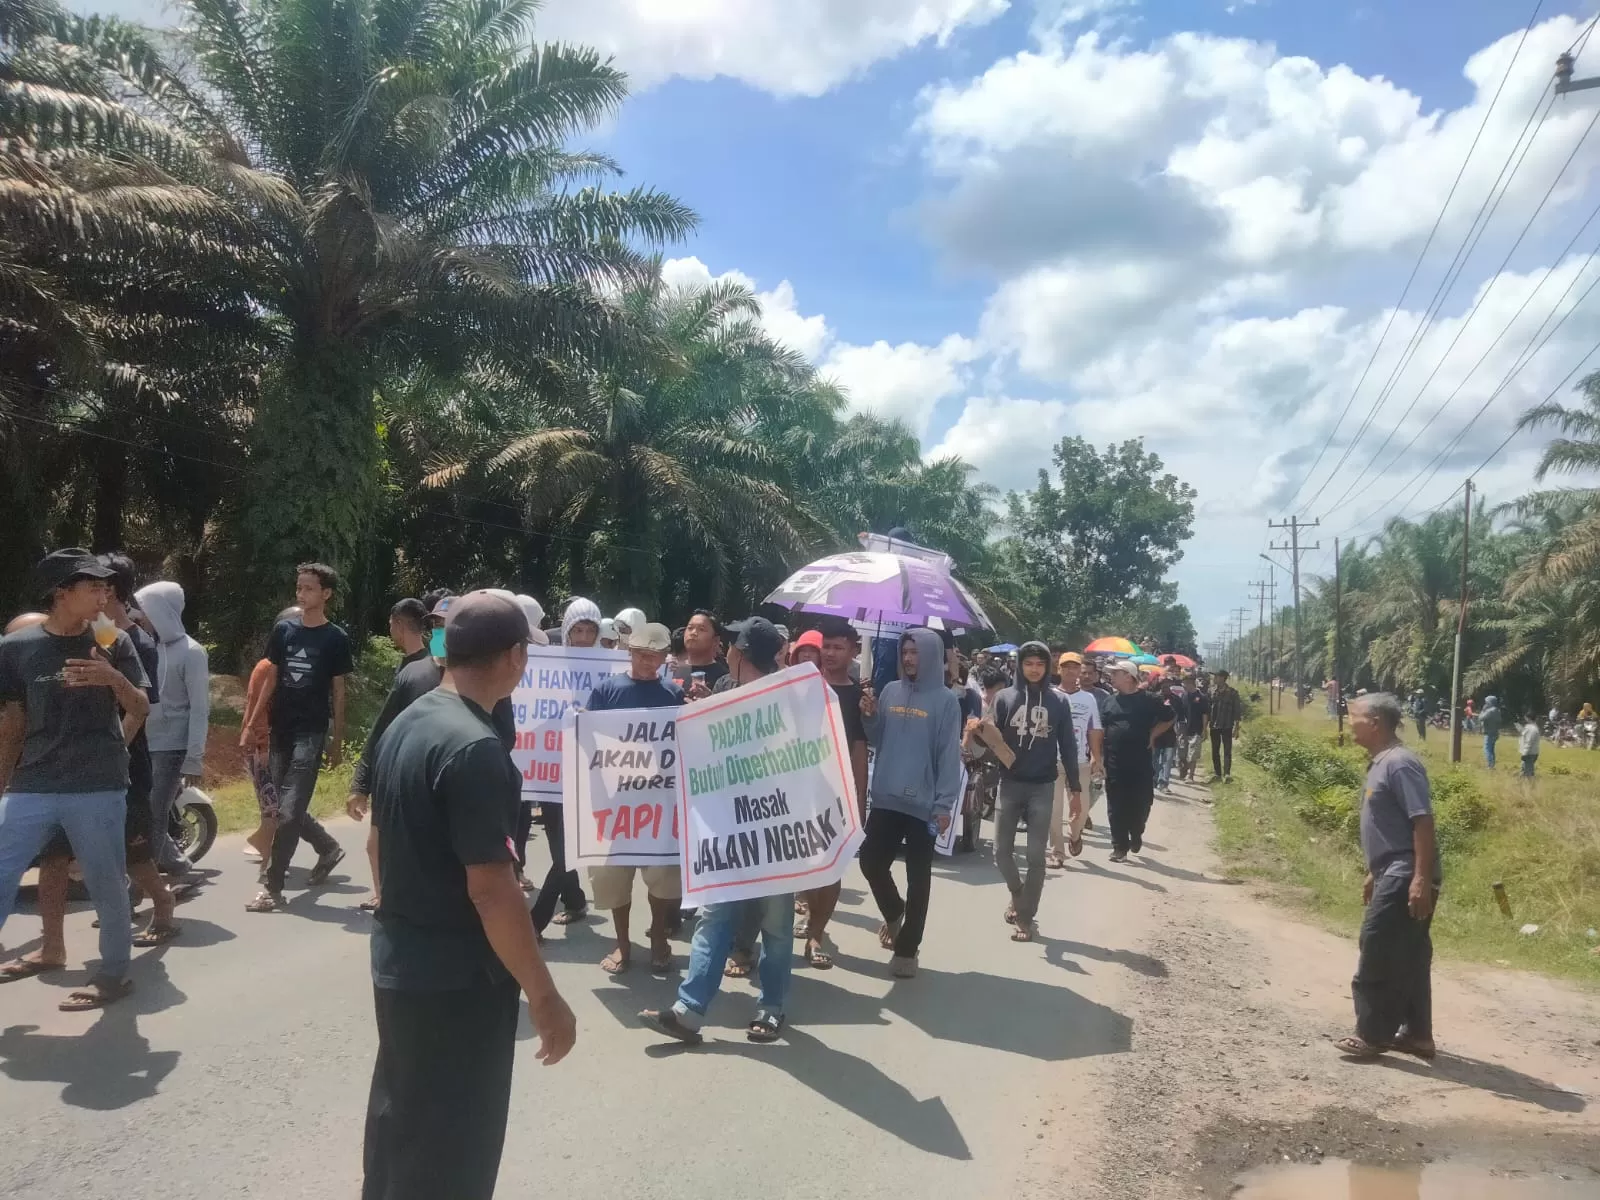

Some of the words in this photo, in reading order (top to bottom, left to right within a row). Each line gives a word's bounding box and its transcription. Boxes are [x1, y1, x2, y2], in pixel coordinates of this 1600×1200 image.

[538, 668, 593, 691] HANYA
[618, 720, 676, 743] JALA
[708, 712, 752, 752] PACAR
[755, 702, 788, 738] AJA
[1010, 704, 1049, 738] 49
[589, 748, 653, 770] AKAN
[689, 760, 725, 796] Butuh
[725, 733, 832, 786] Diperhatikan
[617, 774, 677, 792] HORE
[592, 803, 663, 842] TAPI
[734, 787, 790, 825] Masak
[694, 829, 760, 875] JALAN
